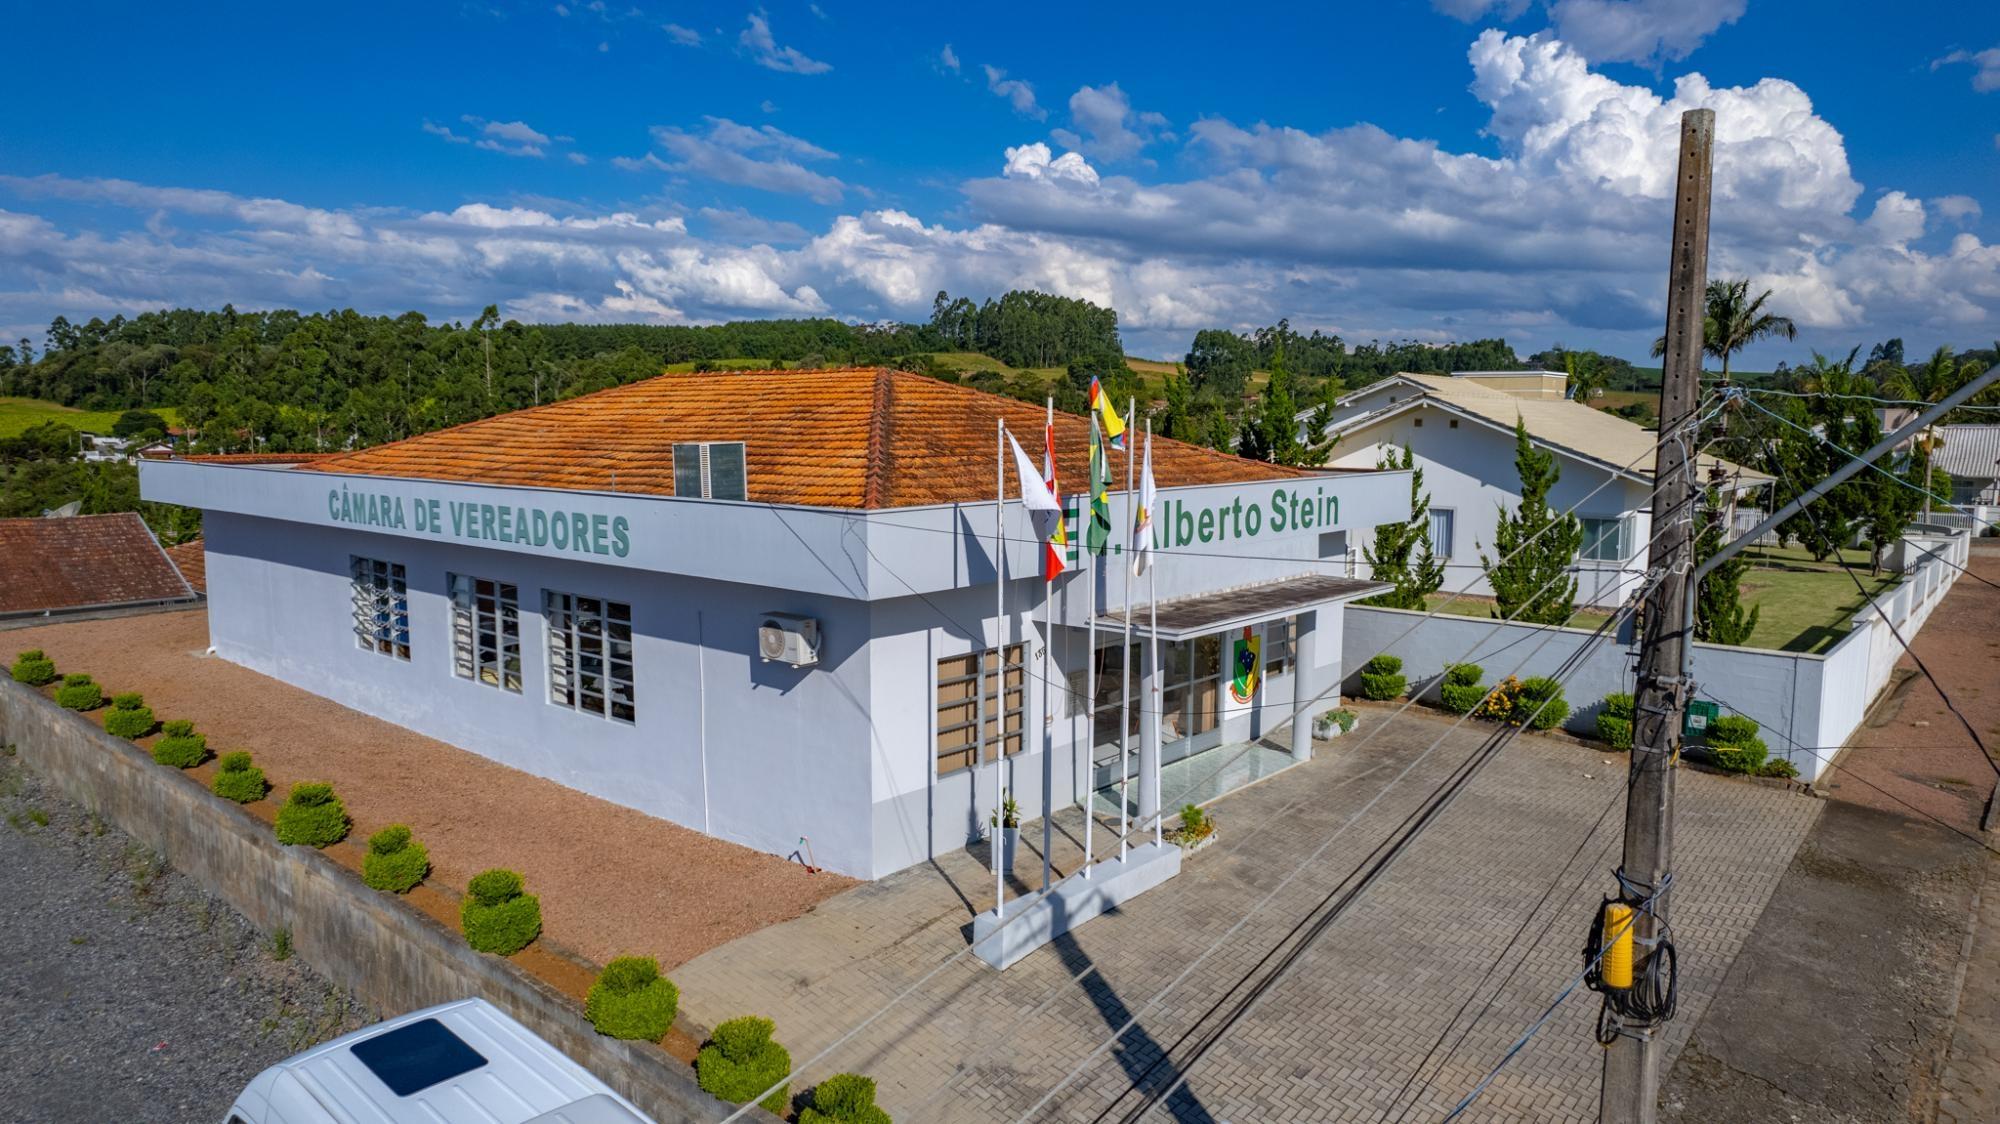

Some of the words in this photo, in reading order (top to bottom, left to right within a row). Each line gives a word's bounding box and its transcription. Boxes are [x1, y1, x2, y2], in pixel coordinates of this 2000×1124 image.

[328, 482, 407, 530] CÂMARA
[414, 497, 442, 534] DE
[449, 500, 630, 559] VEREADORES
[1153, 495, 1262, 550] lberto
[1270, 486, 1340, 533] Stein
